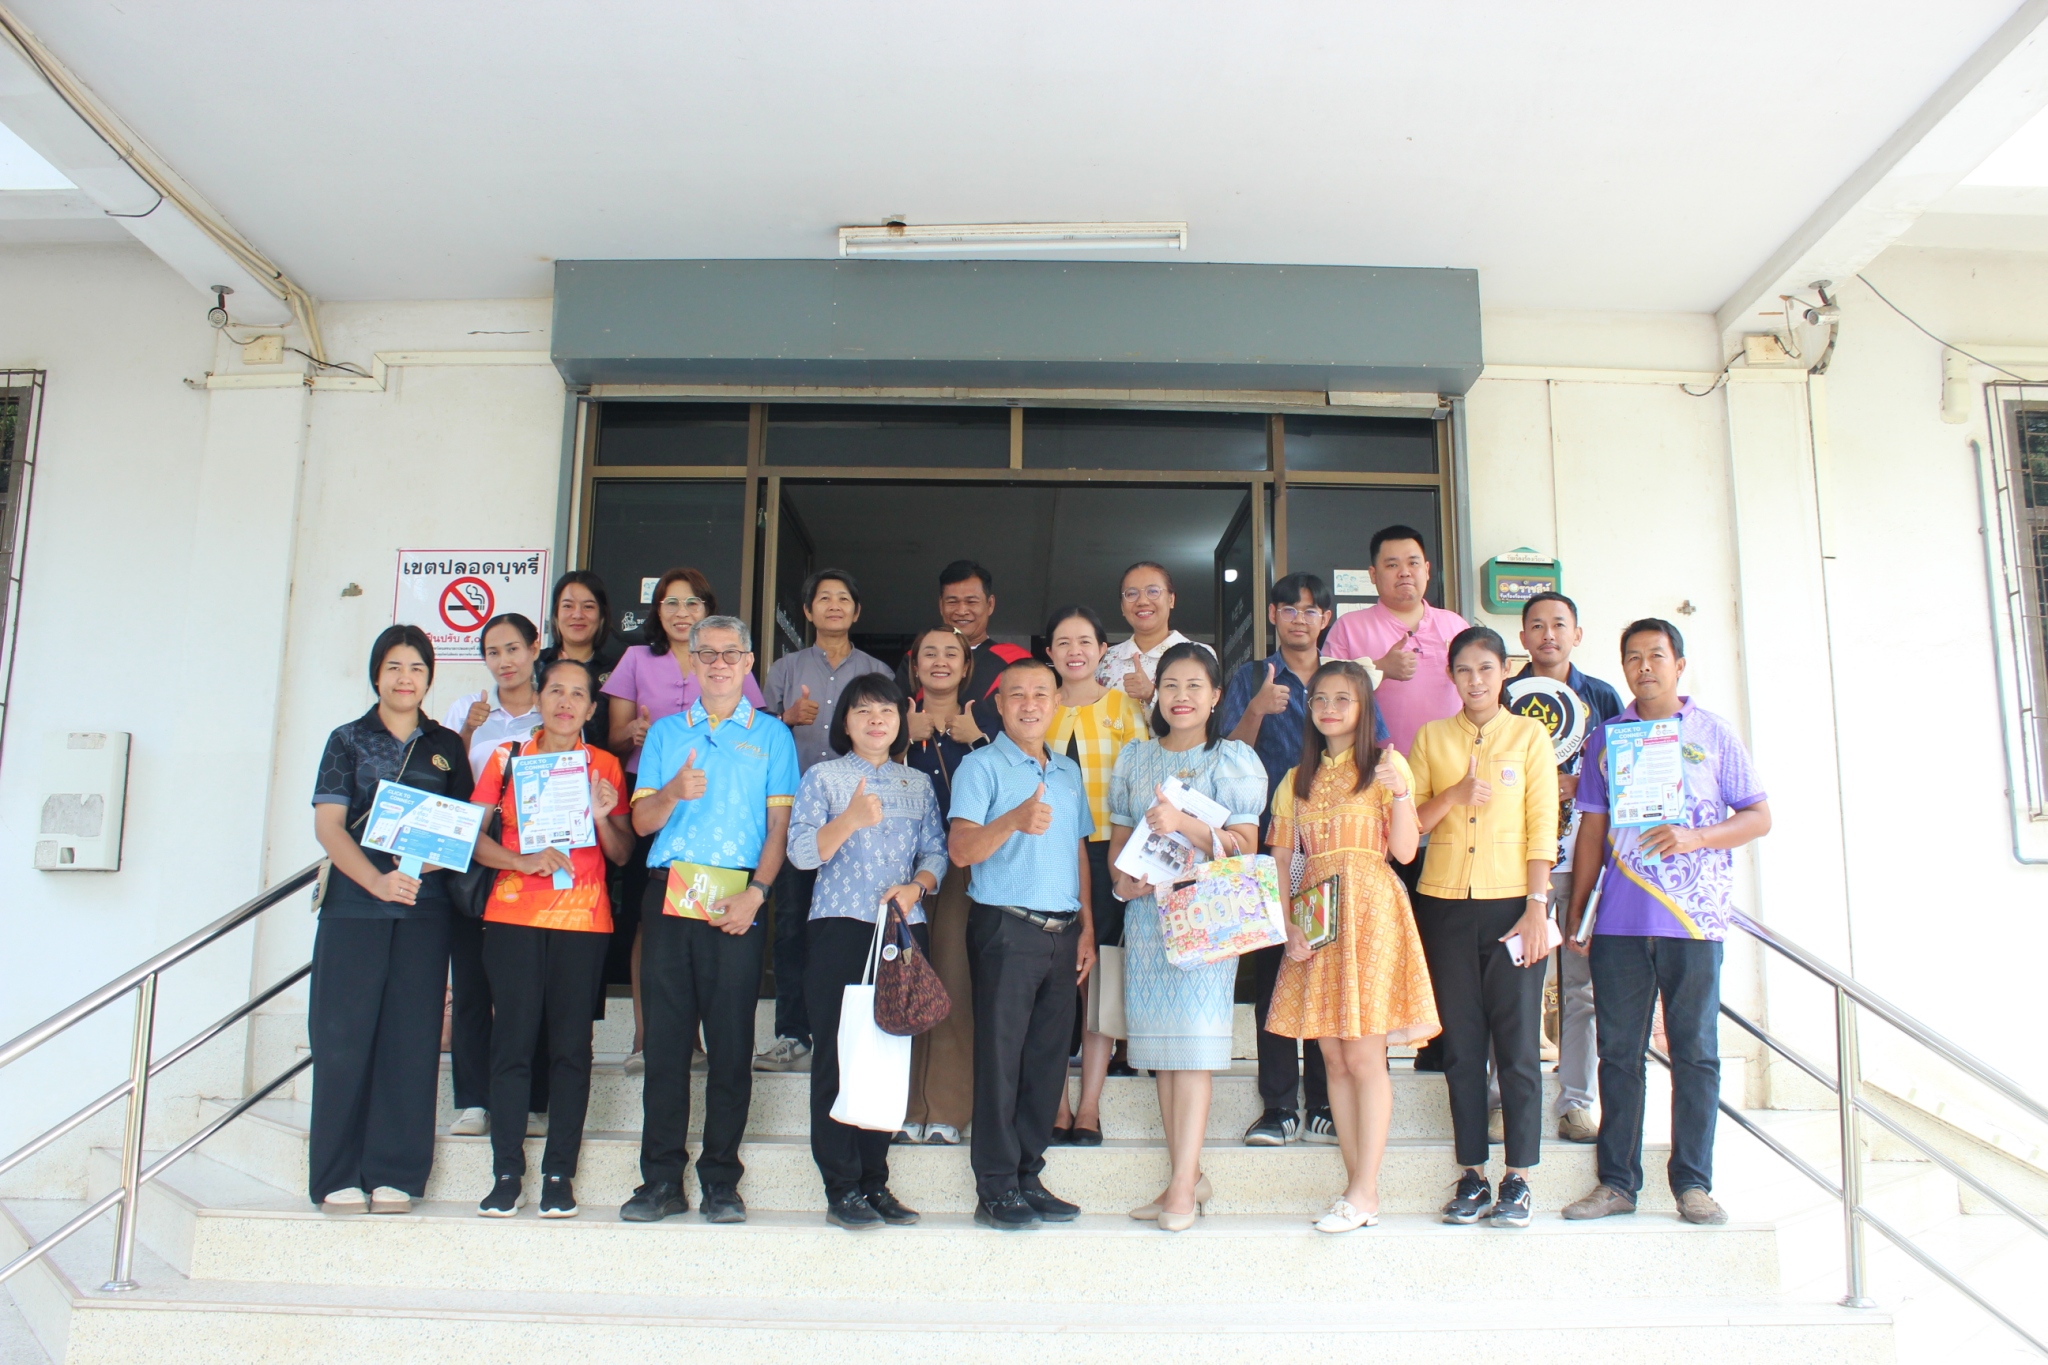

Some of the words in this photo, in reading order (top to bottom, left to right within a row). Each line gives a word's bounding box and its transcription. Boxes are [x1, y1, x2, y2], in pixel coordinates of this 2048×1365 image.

[404, 553, 540, 582] เขตปลอดบุหรี่
[1619, 731, 1647, 739] CONNECT
[524, 763, 553, 771] CONNECT
[387, 789, 402, 798] CLICK
[389, 795, 415, 806] CONNECT
[1169, 889, 1257, 938] BOOK
